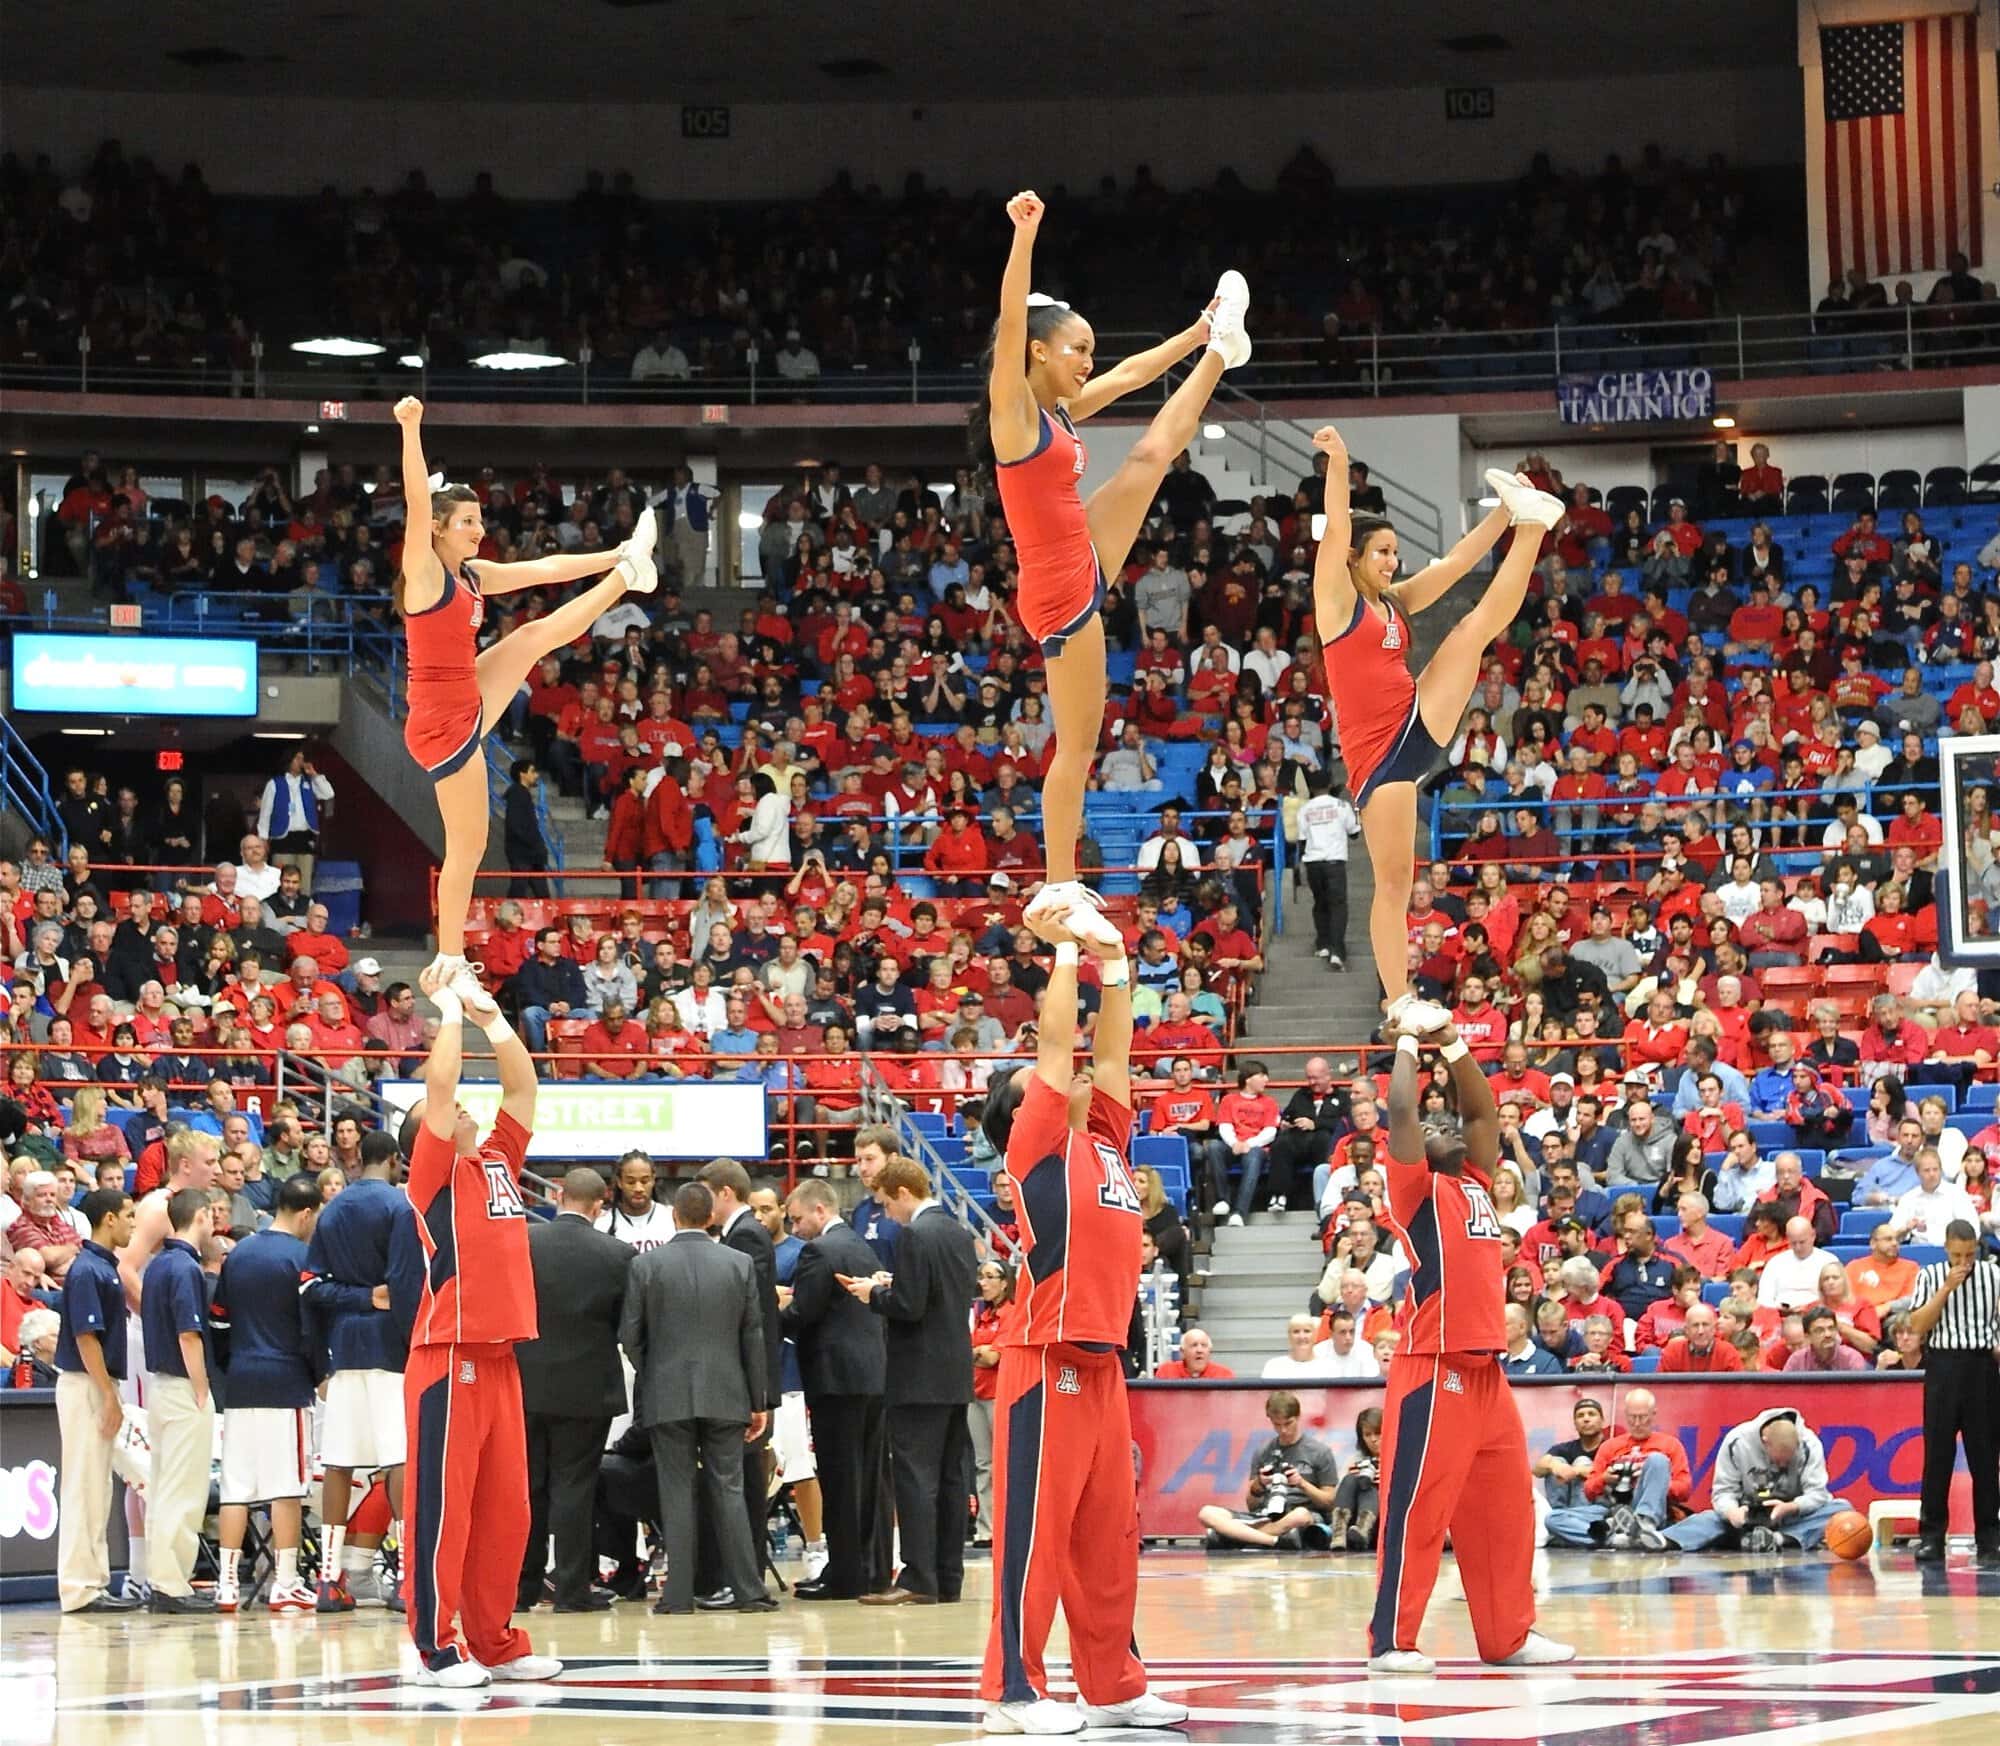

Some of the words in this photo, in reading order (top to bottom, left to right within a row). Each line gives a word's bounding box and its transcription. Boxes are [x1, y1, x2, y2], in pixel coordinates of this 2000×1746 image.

[684, 109, 728, 134] 105
[1598, 368, 1711, 398] GELATO
[1560, 394, 1663, 423] ITALIAN
[1672, 394, 1710, 419] ICE
[1382, 624, 1401, 649] A
[247, 1096, 261, 1114] 6
[537, 1097, 664, 1124] STREET
[928, 1098, 943, 1114] 7
[484, 1161, 526, 1219] A
[1093, 1143, 1142, 1215] A
[1460, 1184, 1502, 1239] A
[1056, 1367, 1080, 1394] A
[1443, 1370, 1464, 1394] A
